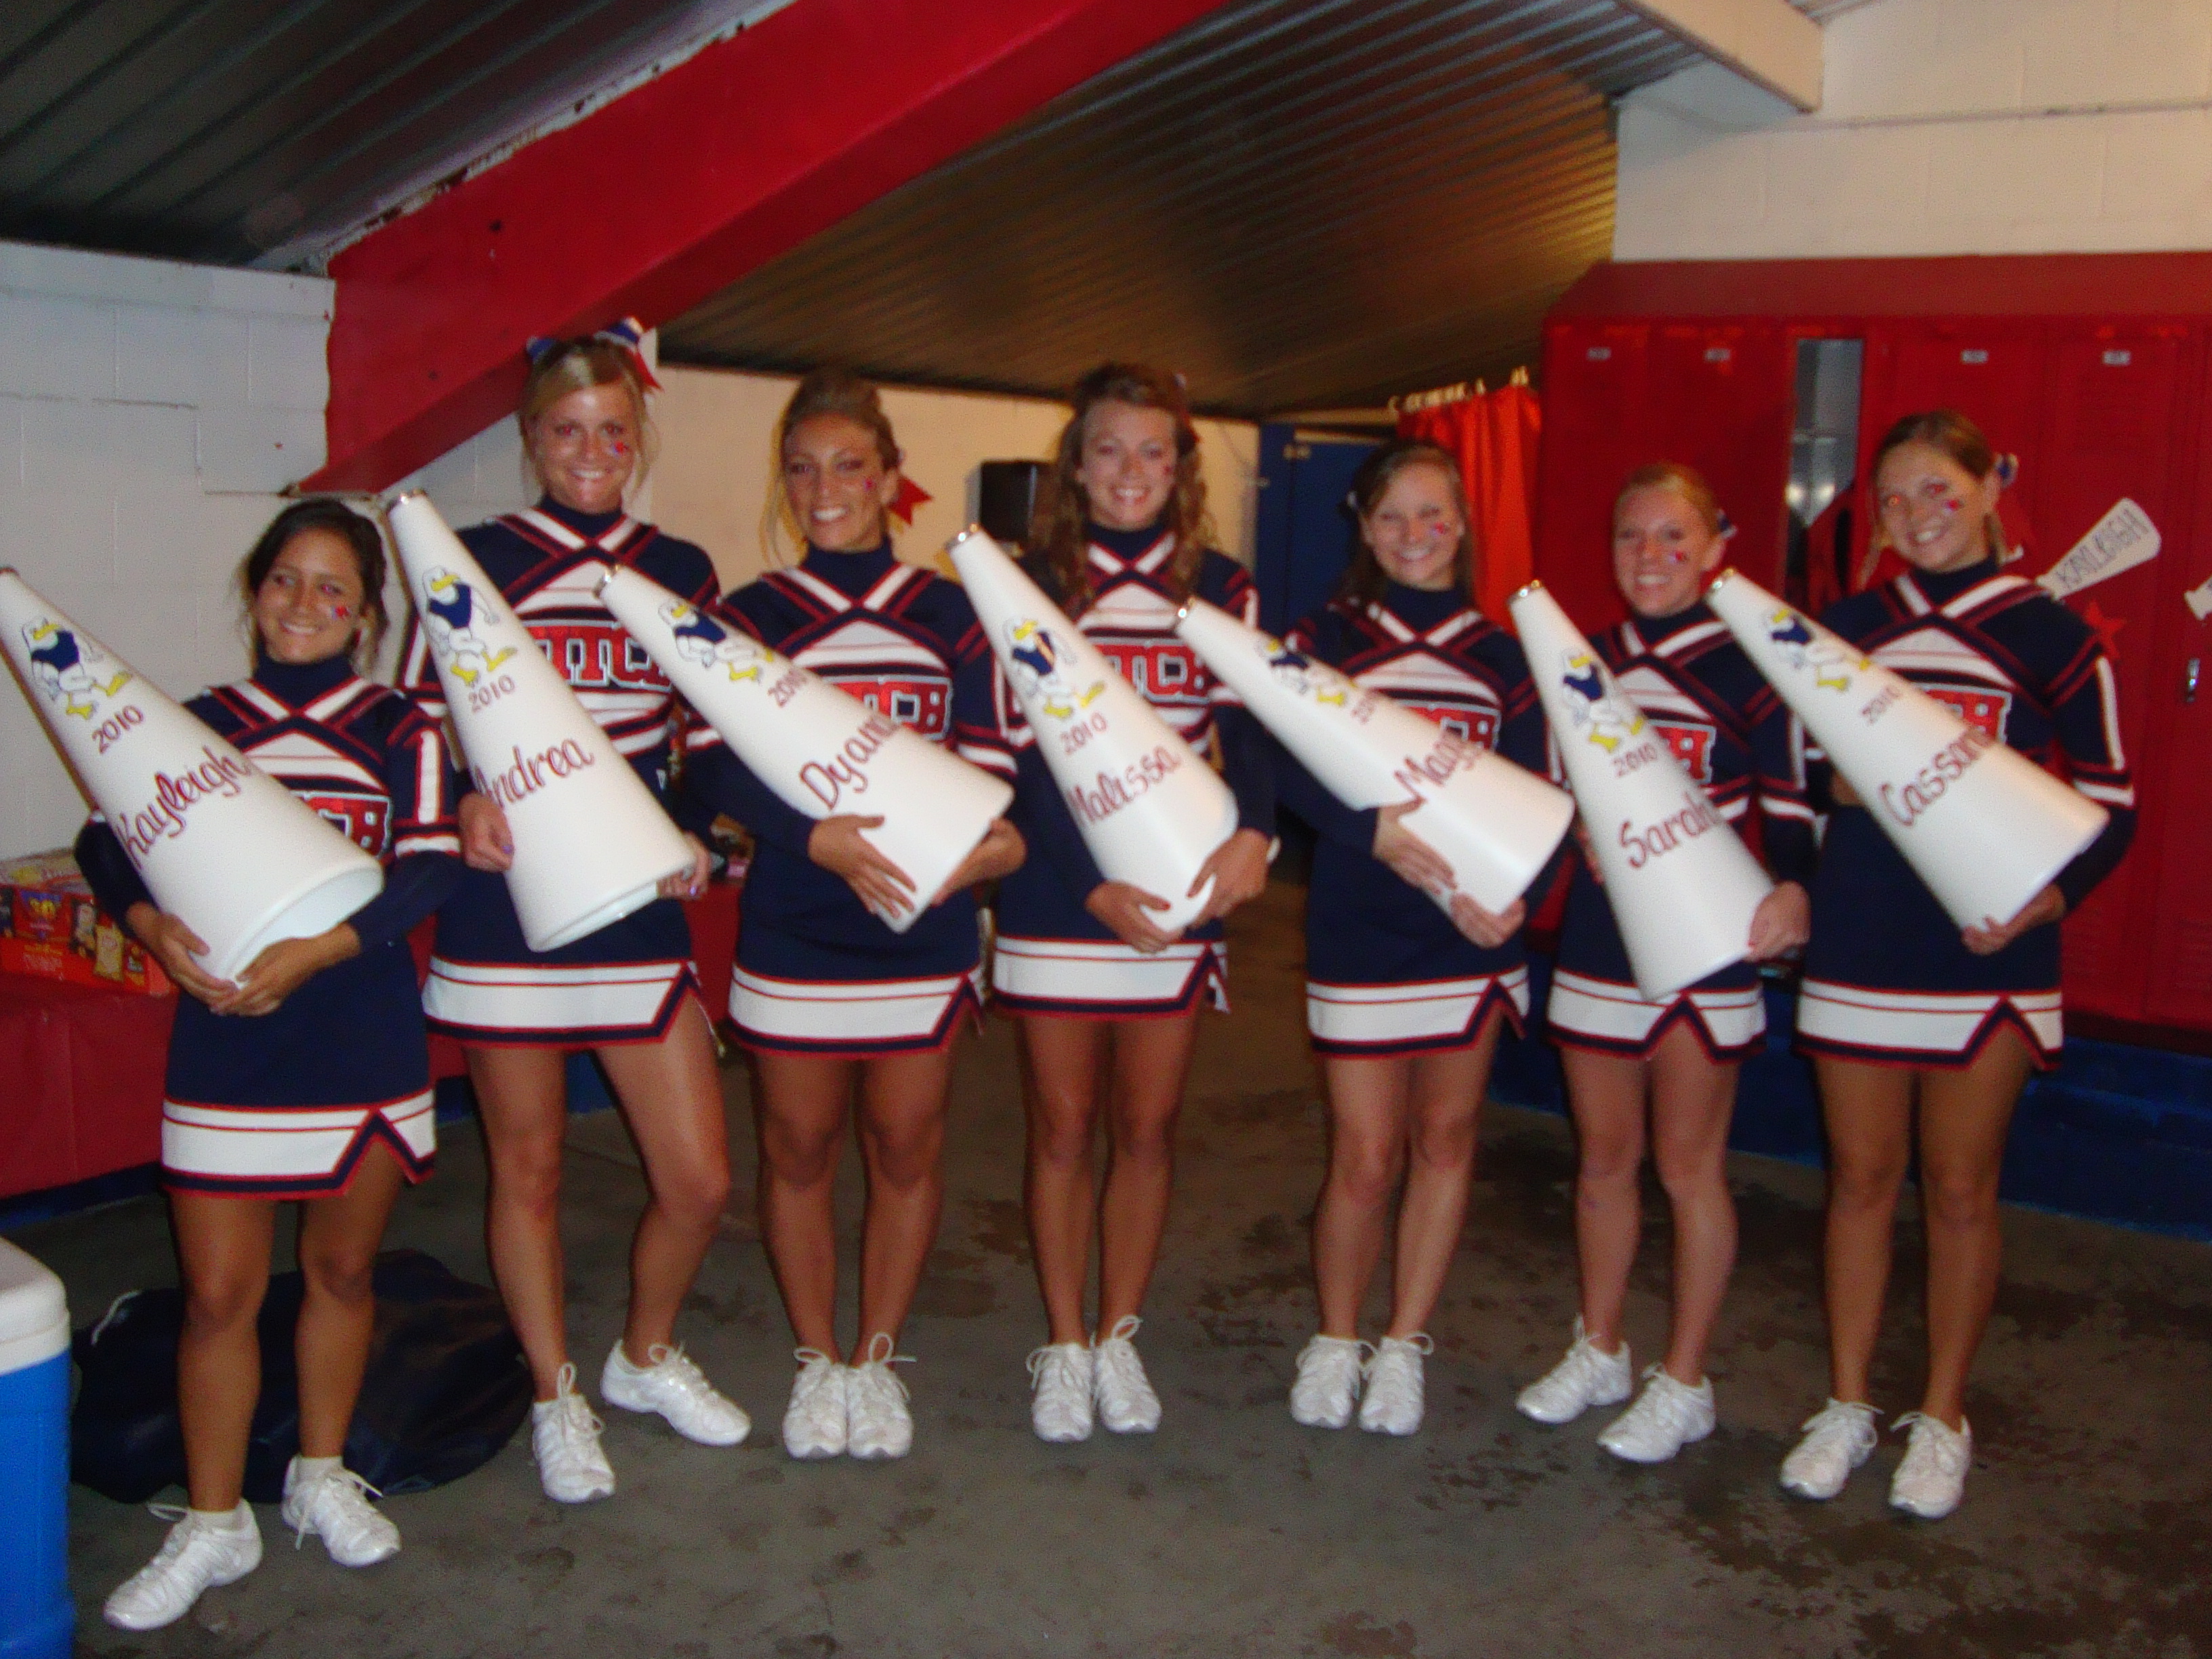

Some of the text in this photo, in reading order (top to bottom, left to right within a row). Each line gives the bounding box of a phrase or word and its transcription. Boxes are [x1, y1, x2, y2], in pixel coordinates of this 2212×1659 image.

[468, 676, 516, 712] 2010
[91, 705, 144, 754] 2010
[1060, 712, 1108, 755] 2010
[1613, 743, 1658, 778] 2010
[118, 745, 252, 867] Kayleigh
